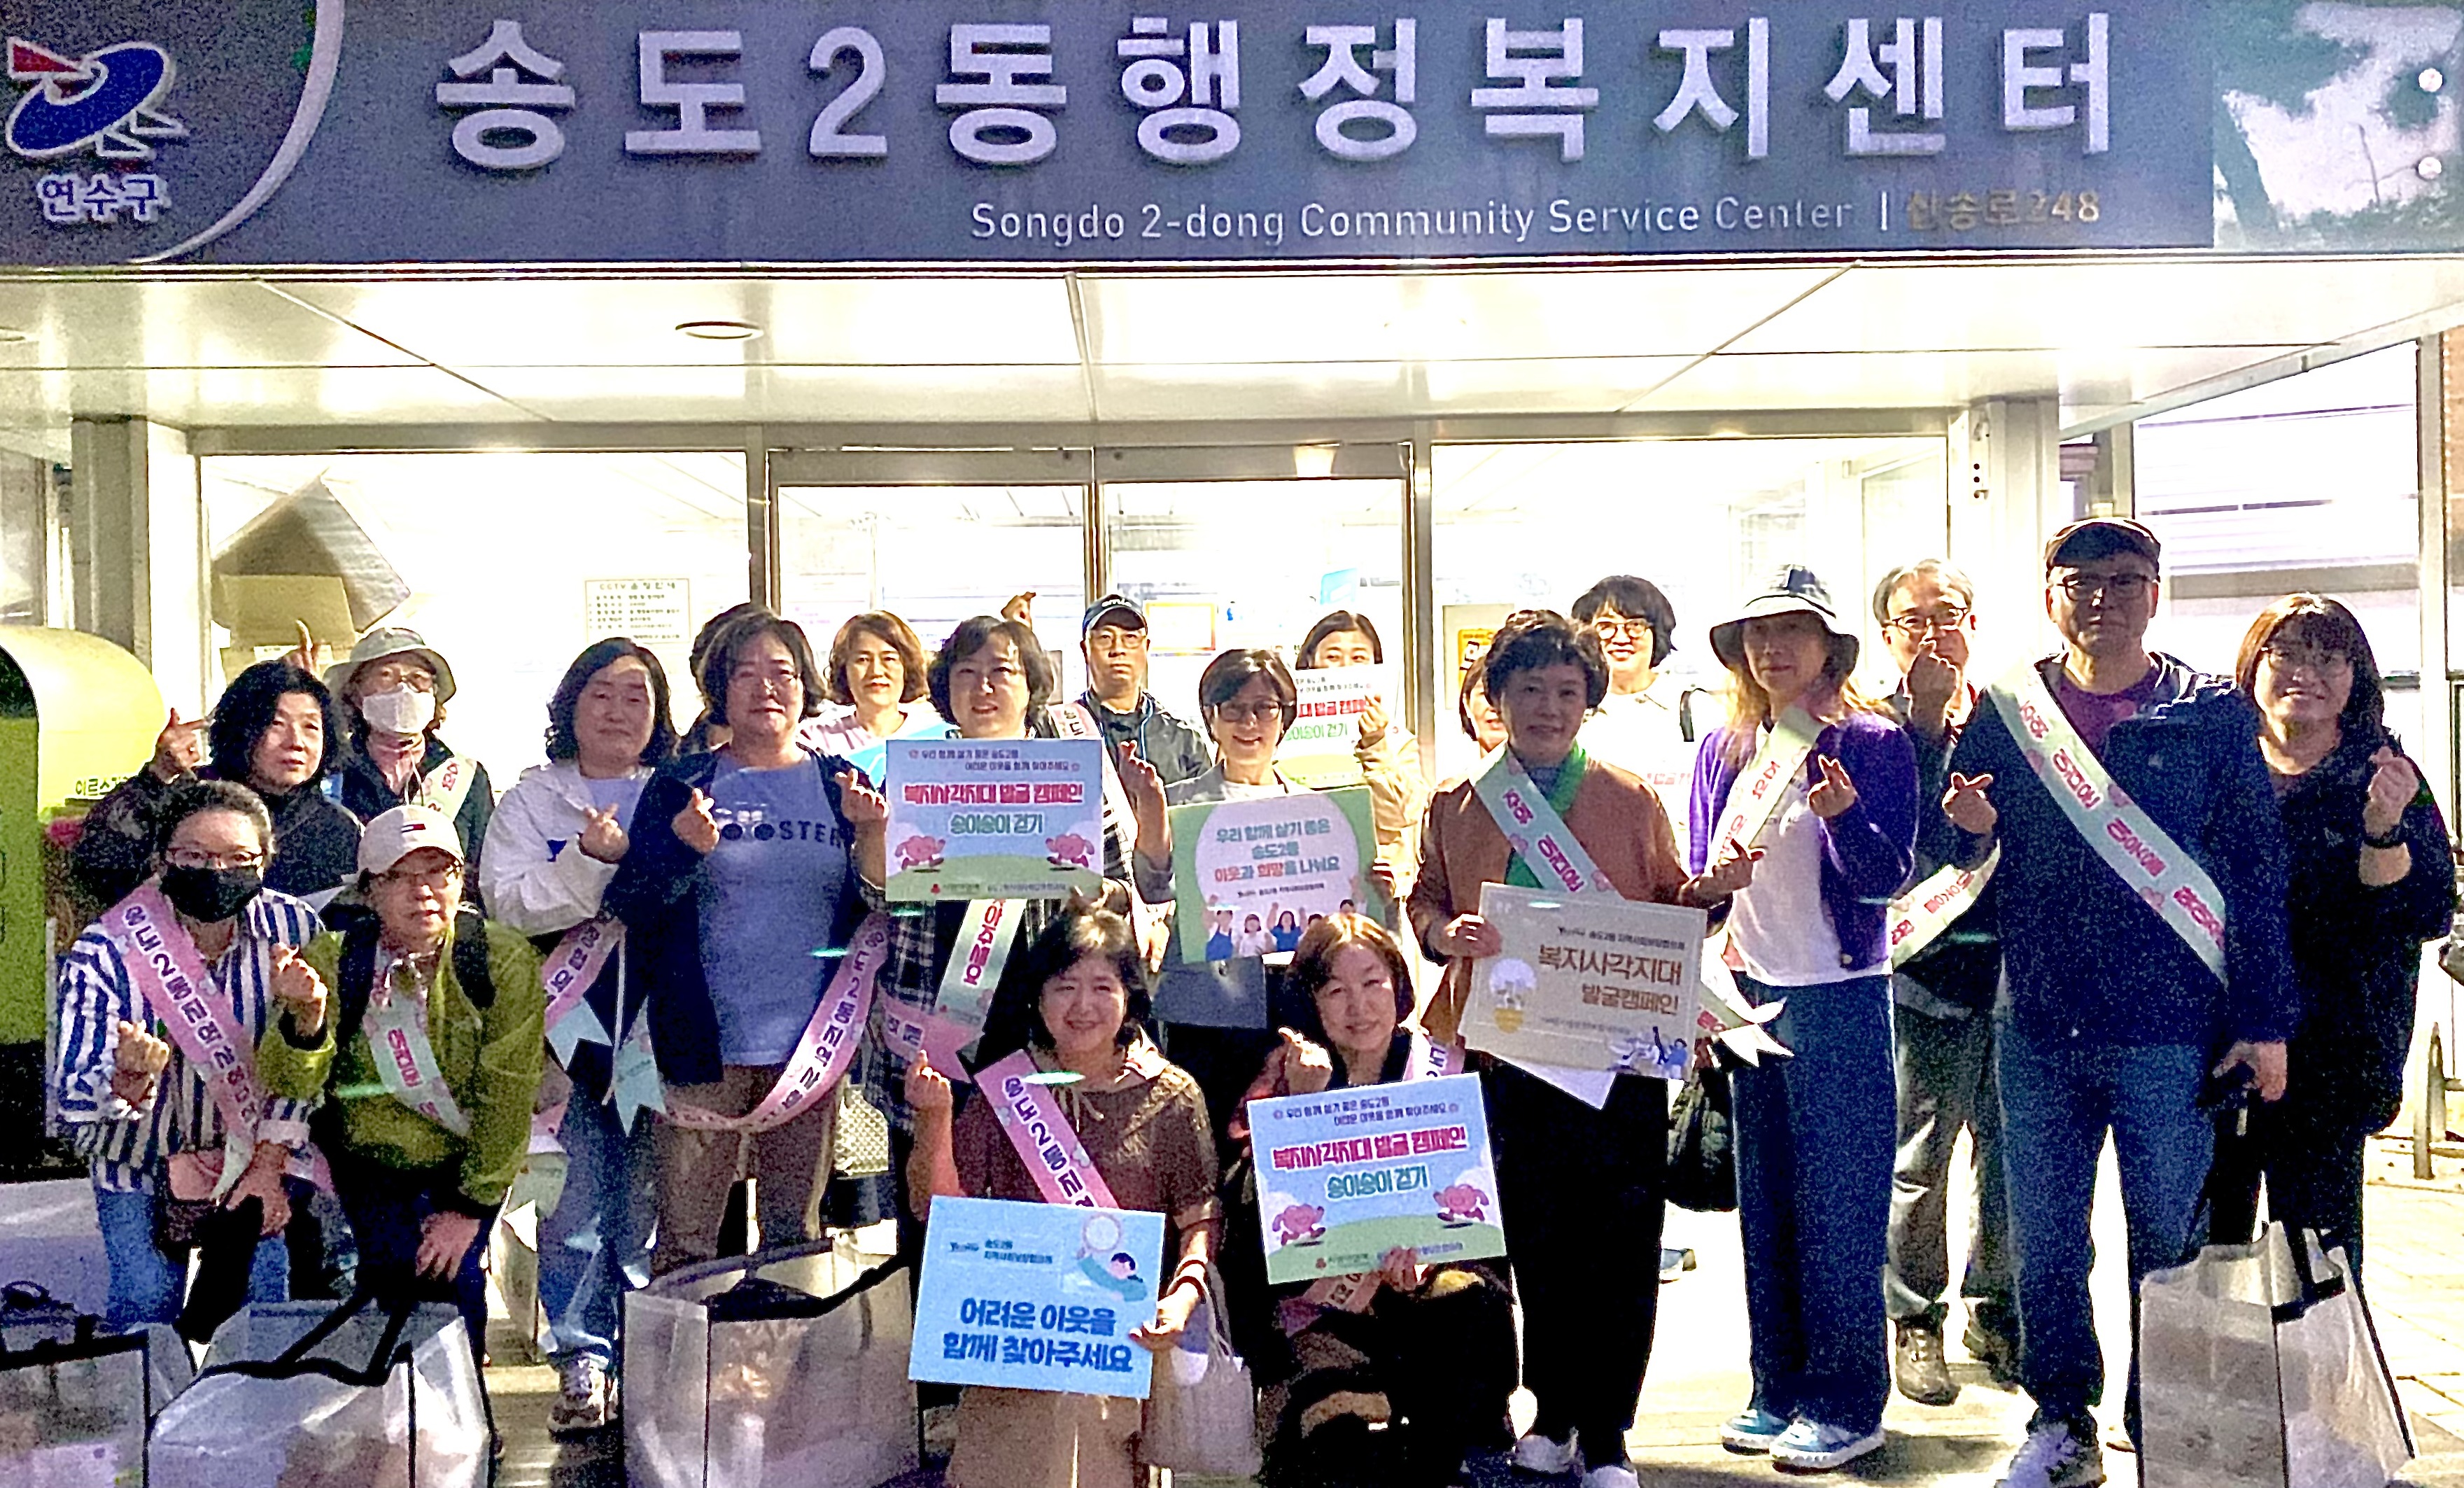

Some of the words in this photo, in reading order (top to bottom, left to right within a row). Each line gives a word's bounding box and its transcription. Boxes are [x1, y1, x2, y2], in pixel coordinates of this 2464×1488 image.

[437, 13, 2111, 169] 송도2동행정복지센터
[38, 174, 170, 221] 연수구
[971, 204, 1125, 247] Songdo
[1141, 203, 1285, 244] 2-dong
[1302, 198, 1534, 242] Community
[1549, 197, 1699, 233] Service
[1716, 196, 1852, 231] Center
[1339, 699, 1366, 715] 캠페
[904, 785, 997, 804] 복지사각지대
[999, 784, 1030, 804] 발굴
[1034, 783, 1083, 803] 캠페인
[950, 814, 1010, 834] 송이송이
[1013, 813, 1043, 833] 걷기
[1216, 827, 1242, 843] 우리
[1245, 824, 1273, 841] 함께
[1275, 821, 1302, 838] 살기
[1304, 817, 1331, 835] 좋은
[1251, 841, 1300, 860] 송도2동
[1214, 864, 1254, 882] 이웃과
[1537, 944, 1683, 985] 복지사각지대
[1582, 983, 1680, 1016] 발굴캠페인
[1273, 1137, 1372, 1170] 복지사각지대
[1374, 1132, 1409, 1159] 발굴
[1412, 1126, 1467, 1155] 캠페인
[1328, 1168, 1393, 1199] 송이송이
[1393, 1165, 1428, 1189] 걷기
[960, 1298, 1036, 1329] 어려운
[1041, 1305, 1116, 1336] 이웃을
[943, 1332, 999, 1362] 함께
[1002, 1335, 1134, 1373] 찾아주세요
